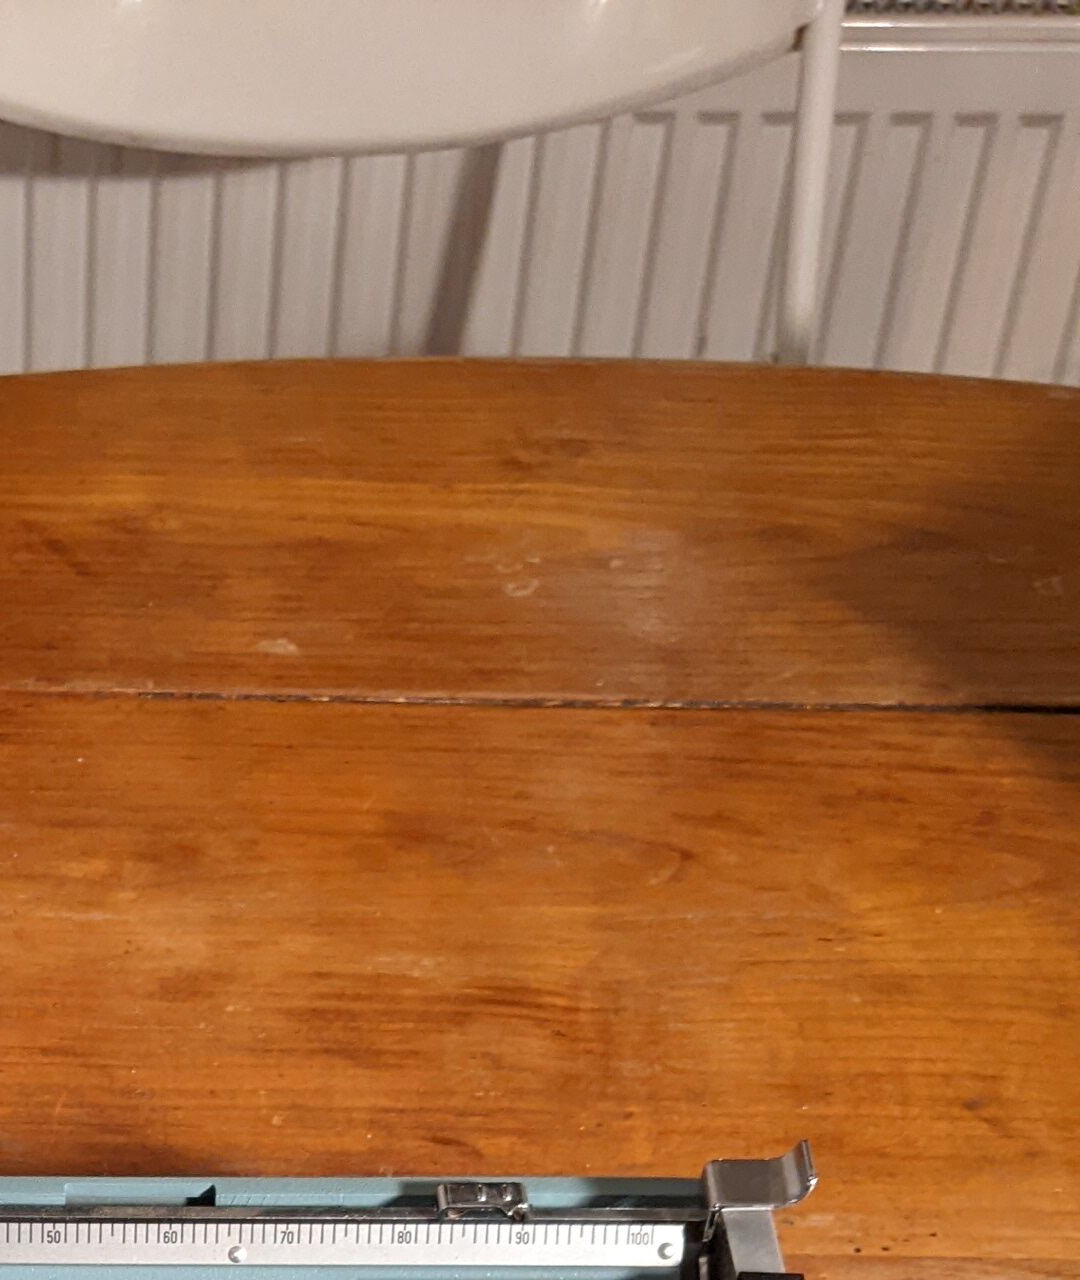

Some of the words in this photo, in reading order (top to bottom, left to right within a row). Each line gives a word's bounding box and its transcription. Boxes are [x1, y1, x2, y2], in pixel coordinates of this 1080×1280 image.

[46, 1230, 61, 1244] 50
[162, 1230, 177, 1244] 60
[280, 1230, 295, 1244] 70
[397, 1230, 412, 1245] 80
[514, 1231, 530, 1245] 90
[631, 1231, 650, 1246] 100
